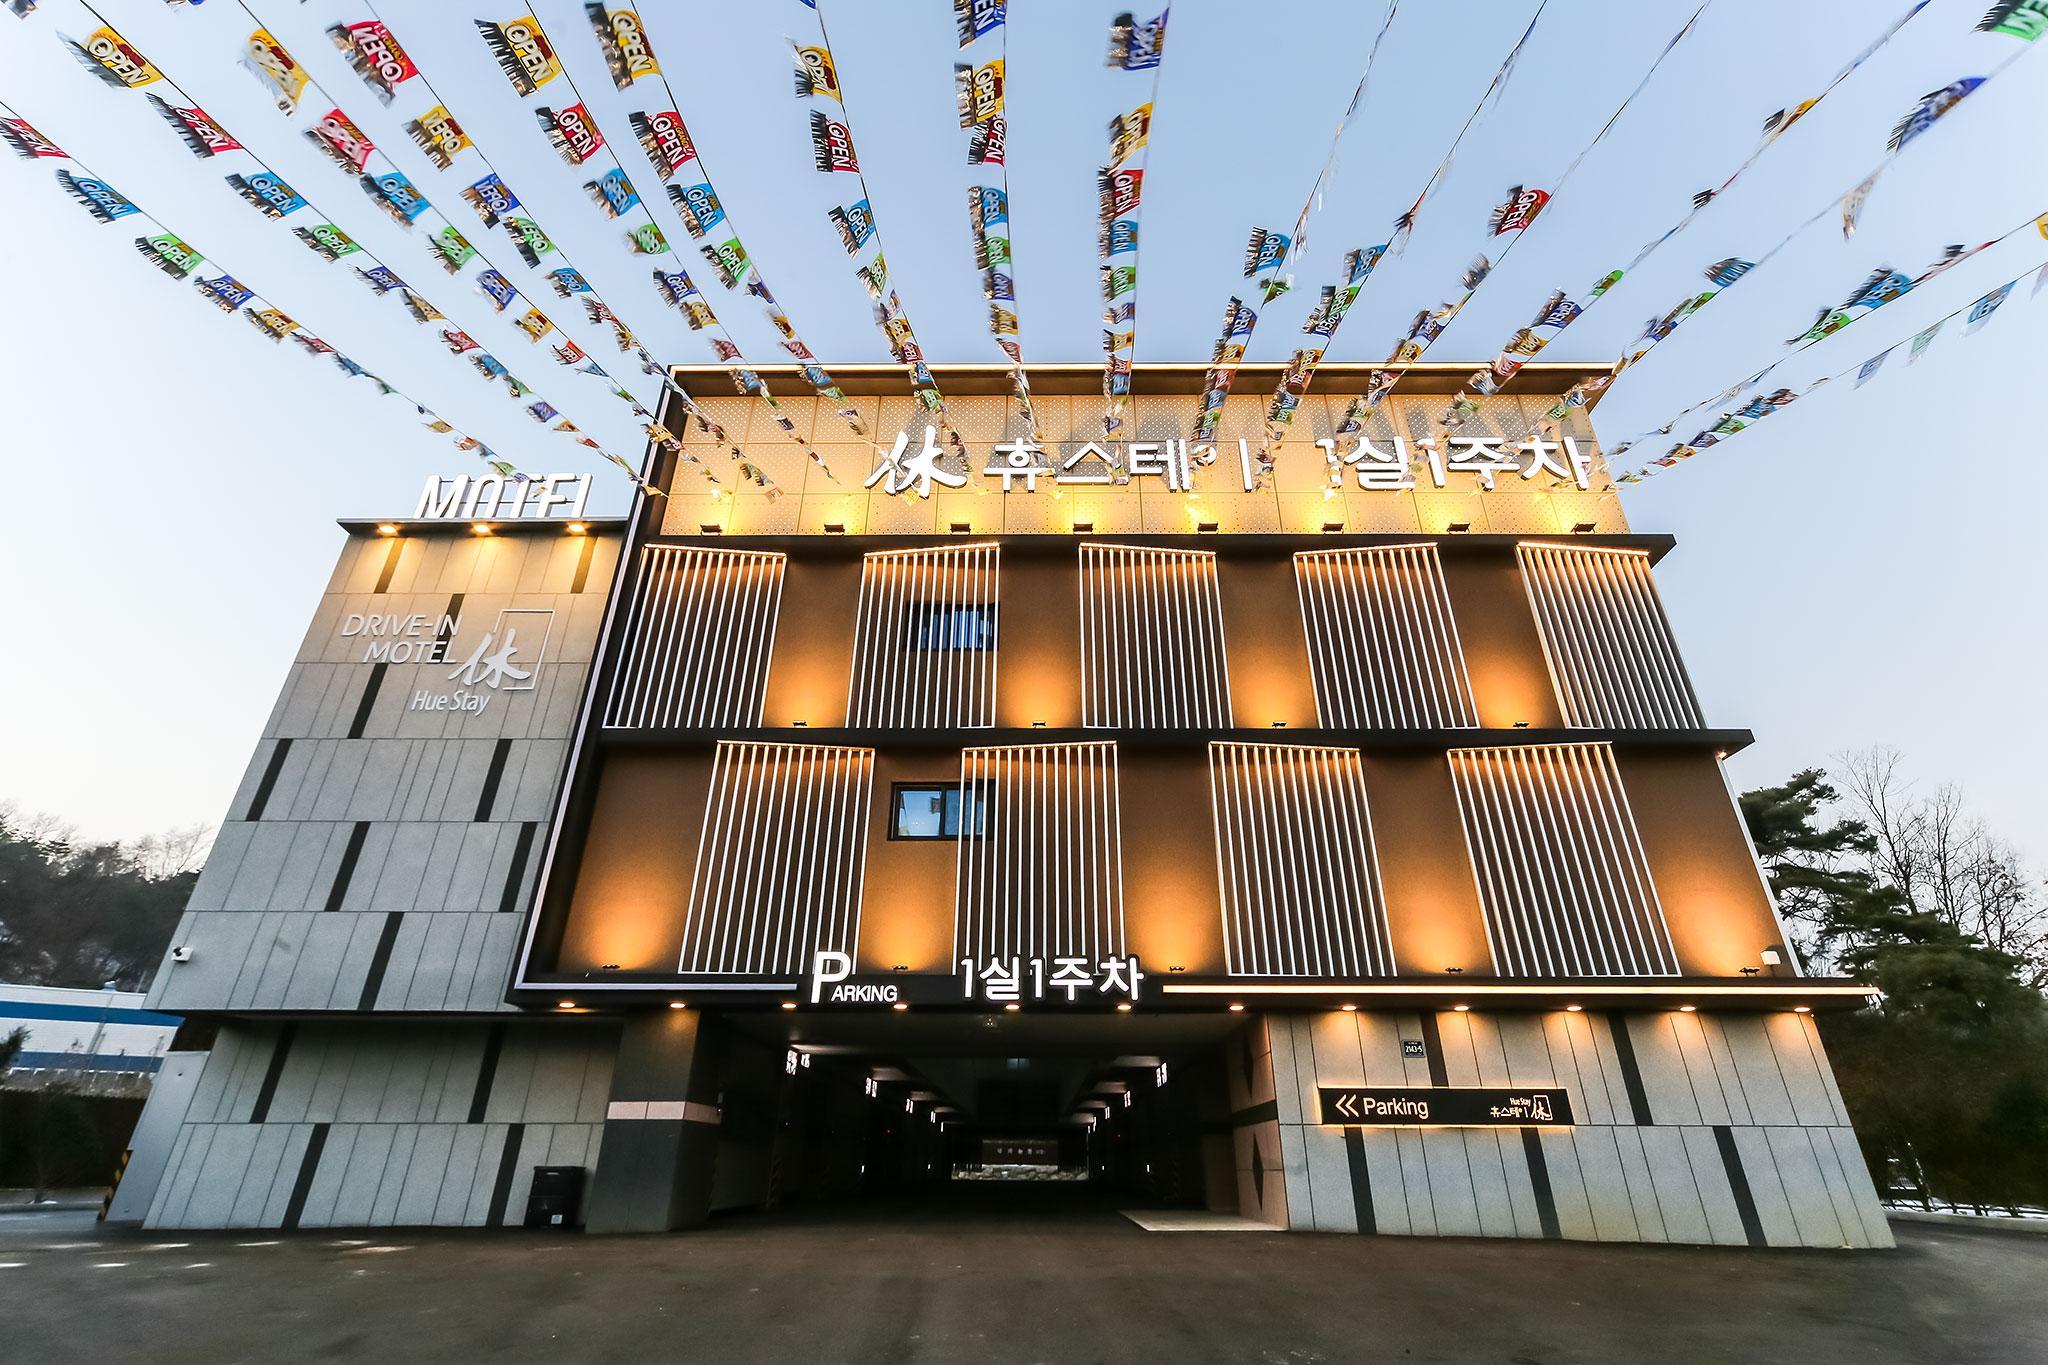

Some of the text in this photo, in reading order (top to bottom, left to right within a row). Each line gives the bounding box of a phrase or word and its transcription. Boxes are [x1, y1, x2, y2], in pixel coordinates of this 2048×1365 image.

[88, 38, 151, 84] OPEN
[505, 24, 551, 83] OPEN
[612, 13, 652, 72] OPEN
[974, 67, 995, 117] OPEN
[175, 107, 229, 148] OPEN
[559, 110, 596, 156] OPEN
[652, 117, 687, 166] OPEN
[828, 124, 851, 167] OPEN
[986, 120, 1006, 160] OPEN
[77, 180, 129, 215] OPEN
[251, 177, 297, 211] OPEN
[686, 187, 717, 227] OPEN
[1115, 174, 1133, 213] OPEN
[1501, 192, 1538, 230] OPEN
[313, 227, 351, 255] OPEN
[847, 207, 868, 245] OPEN
[1112, 223, 1131, 251] OPEN
[153, 239, 197, 271] OPEN
[719, 244, 744, 277] OPEN
[1257, 234, 1281, 266] OPEN
[211, 280, 246, 303] OPEN
[666, 275, 690, 299] OPEN
[260, 312, 292, 335] OPEN
[864, 425, 967, 499] 休
[983, 437, 1252, 493] 휴스테이
[341, 615, 462, 637] DRIVE-IN
[362, 641, 458, 664] MOTEL
[448, 628, 531, 689] 休
[411, 690, 491, 716] Hue Stay
[960, 954, 1146, 1001] 1실1주차
[1363, 1097, 1429, 1120] Parking
[1531, 1101, 1551, 1120] 休
